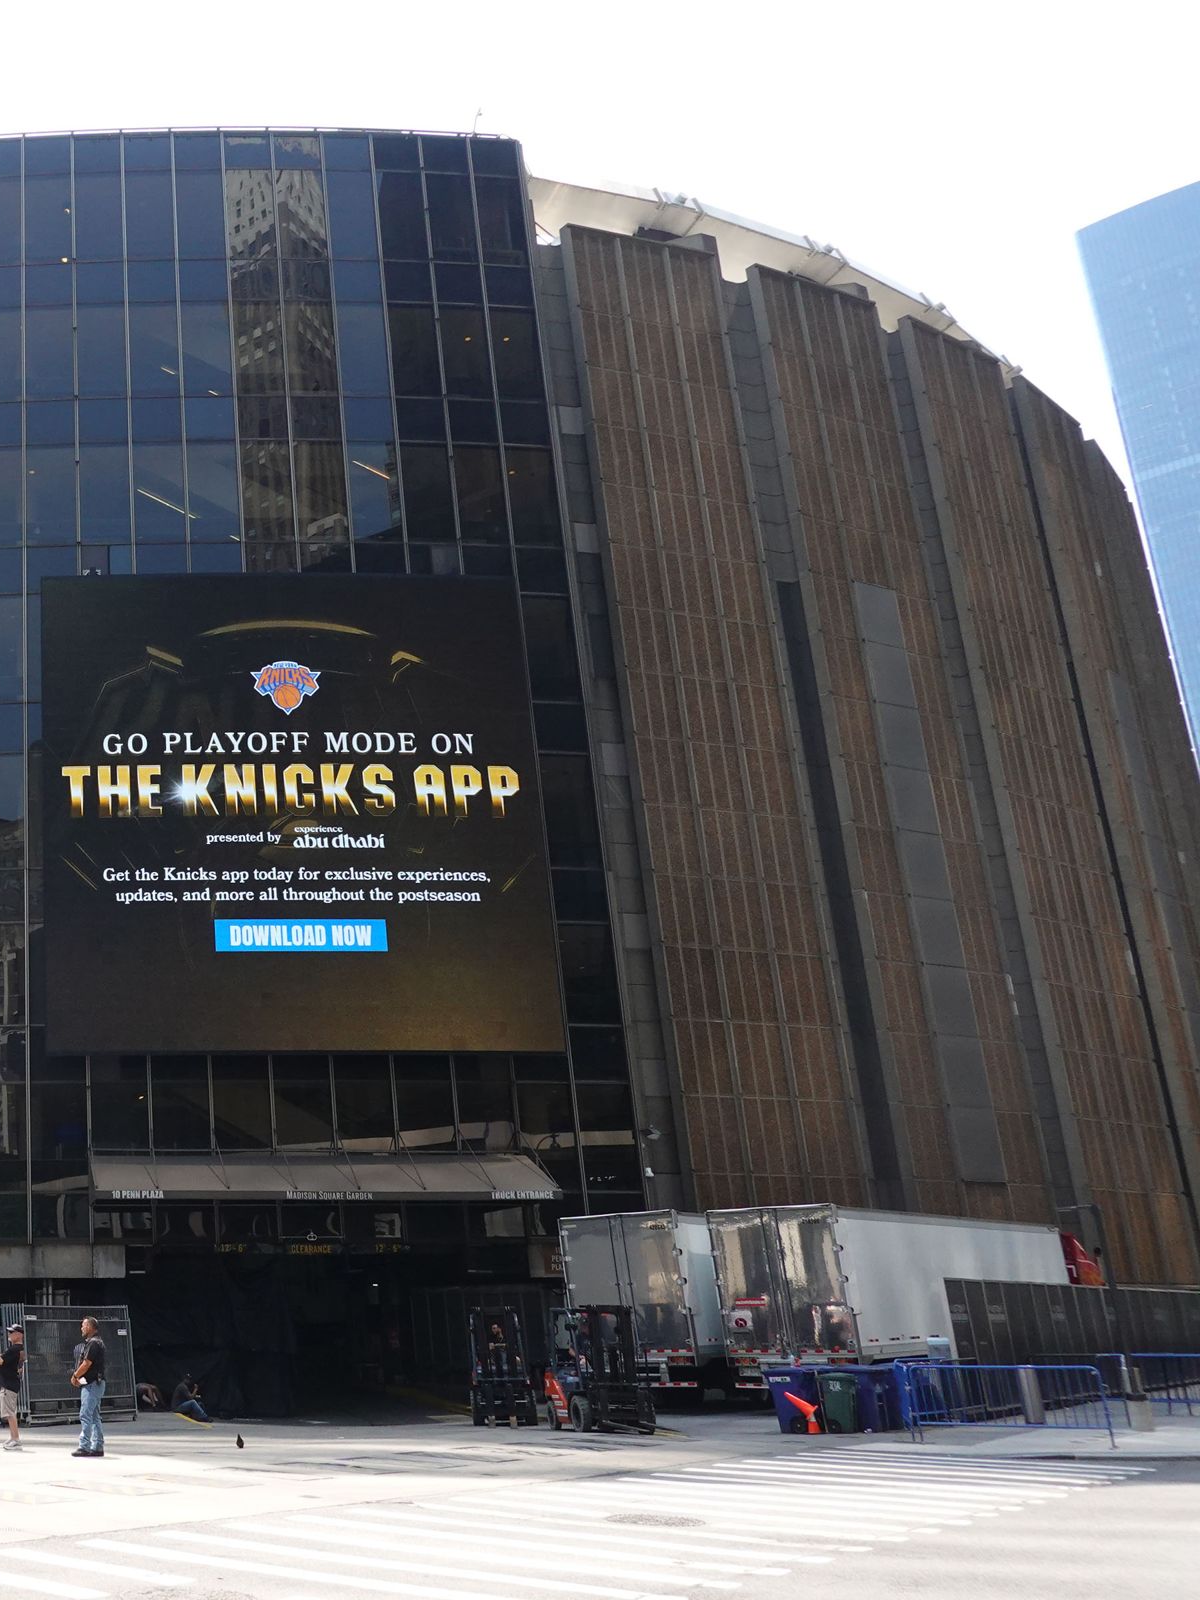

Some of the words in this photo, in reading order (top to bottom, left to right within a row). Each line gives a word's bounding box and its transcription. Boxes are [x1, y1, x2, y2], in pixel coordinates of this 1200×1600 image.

[257, 667, 317, 689] KNICKS
[102, 733, 148, 755] GO
[162, 732, 310, 755] PLAYOFF
[323, 732, 417, 755] MODE
[431, 733, 474, 755] ON
[61, 764, 163, 818] THE
[180, 763, 397, 817] KNICKS
[413, 764, 520, 819] APP
[294, 825, 343, 833] experience
[206, 831, 264, 845] presented
[267, 831, 282, 845] by
[293, 833, 329, 849] abu
[102, 867, 131, 882] Get
[135, 867, 159, 881] the
[163, 866, 217, 881] Knicks
[221, 869, 249, 884] app
[253, 866, 294, 884] today
[298, 866, 321, 881] for
[324, 866, 393, 881] exclusive
[397, 867, 491, 884] experiences,
[115, 887, 178, 905] updates,
[182, 887, 211, 902] and
[215, 889, 255, 901] more
[259, 886, 278, 901] all
[282, 887, 365, 904] throughout
[369, 887, 394, 901] the
[398, 889, 481, 904] postseason
[229, 925, 327, 947] DOWNLOAD
[331, 925, 372, 947] NOW
[111, 1190, 121, 1199] 10
[121, 1190, 141, 1199] PENN
[141, 1190, 164, 1199] PLAZA
[286, 1190, 318, 1200] MADISON
[318, 1191, 345, 1200] SQUARE
[346, 1191, 373, 1200] GARDEN
[491, 1190, 516, 1200] TRUCK
[516, 1190, 554, 1199] ENTRANCE
[291, 1244, 333, 1254] CLEARANCE
